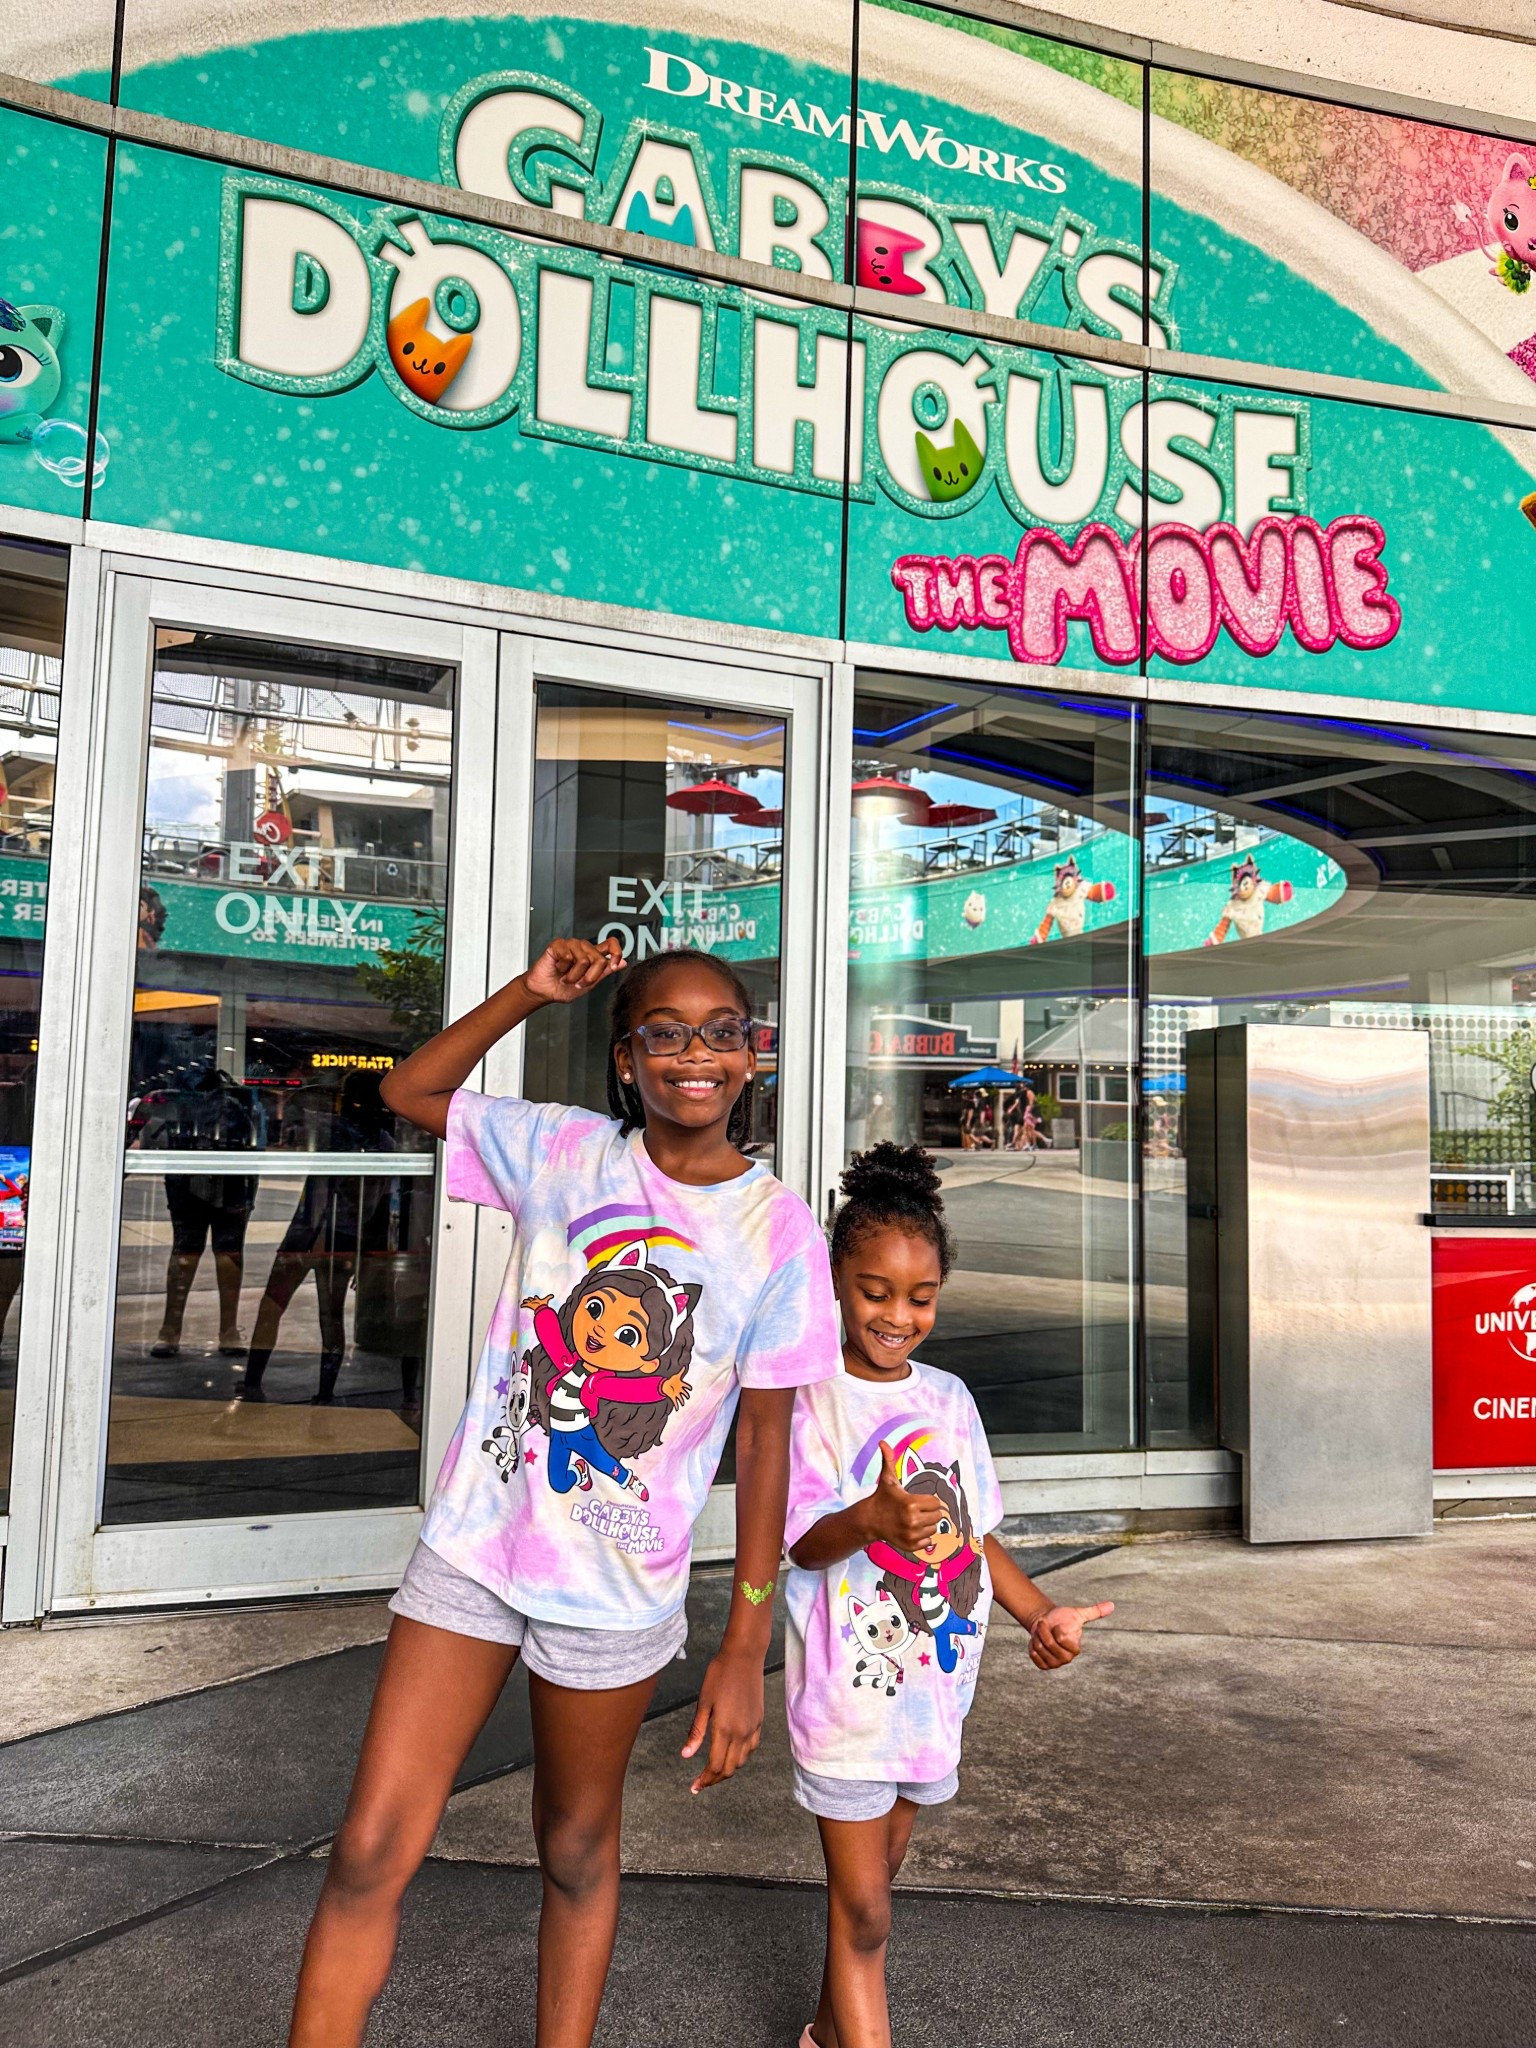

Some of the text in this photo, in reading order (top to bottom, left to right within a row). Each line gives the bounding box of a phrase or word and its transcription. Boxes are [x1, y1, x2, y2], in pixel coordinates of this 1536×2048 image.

[446, 78, 1174, 380] GABBY'S
[234, 182, 1306, 528] DOLLHOUSE
[896, 515, 1400, 666] THE MOVIE
[229, 841, 358, 891] EXIT
[215, 891, 367, 938] ONLY
[608, 874, 713, 917] EXIT
[627, 1538, 665, 1554] MOVIE
